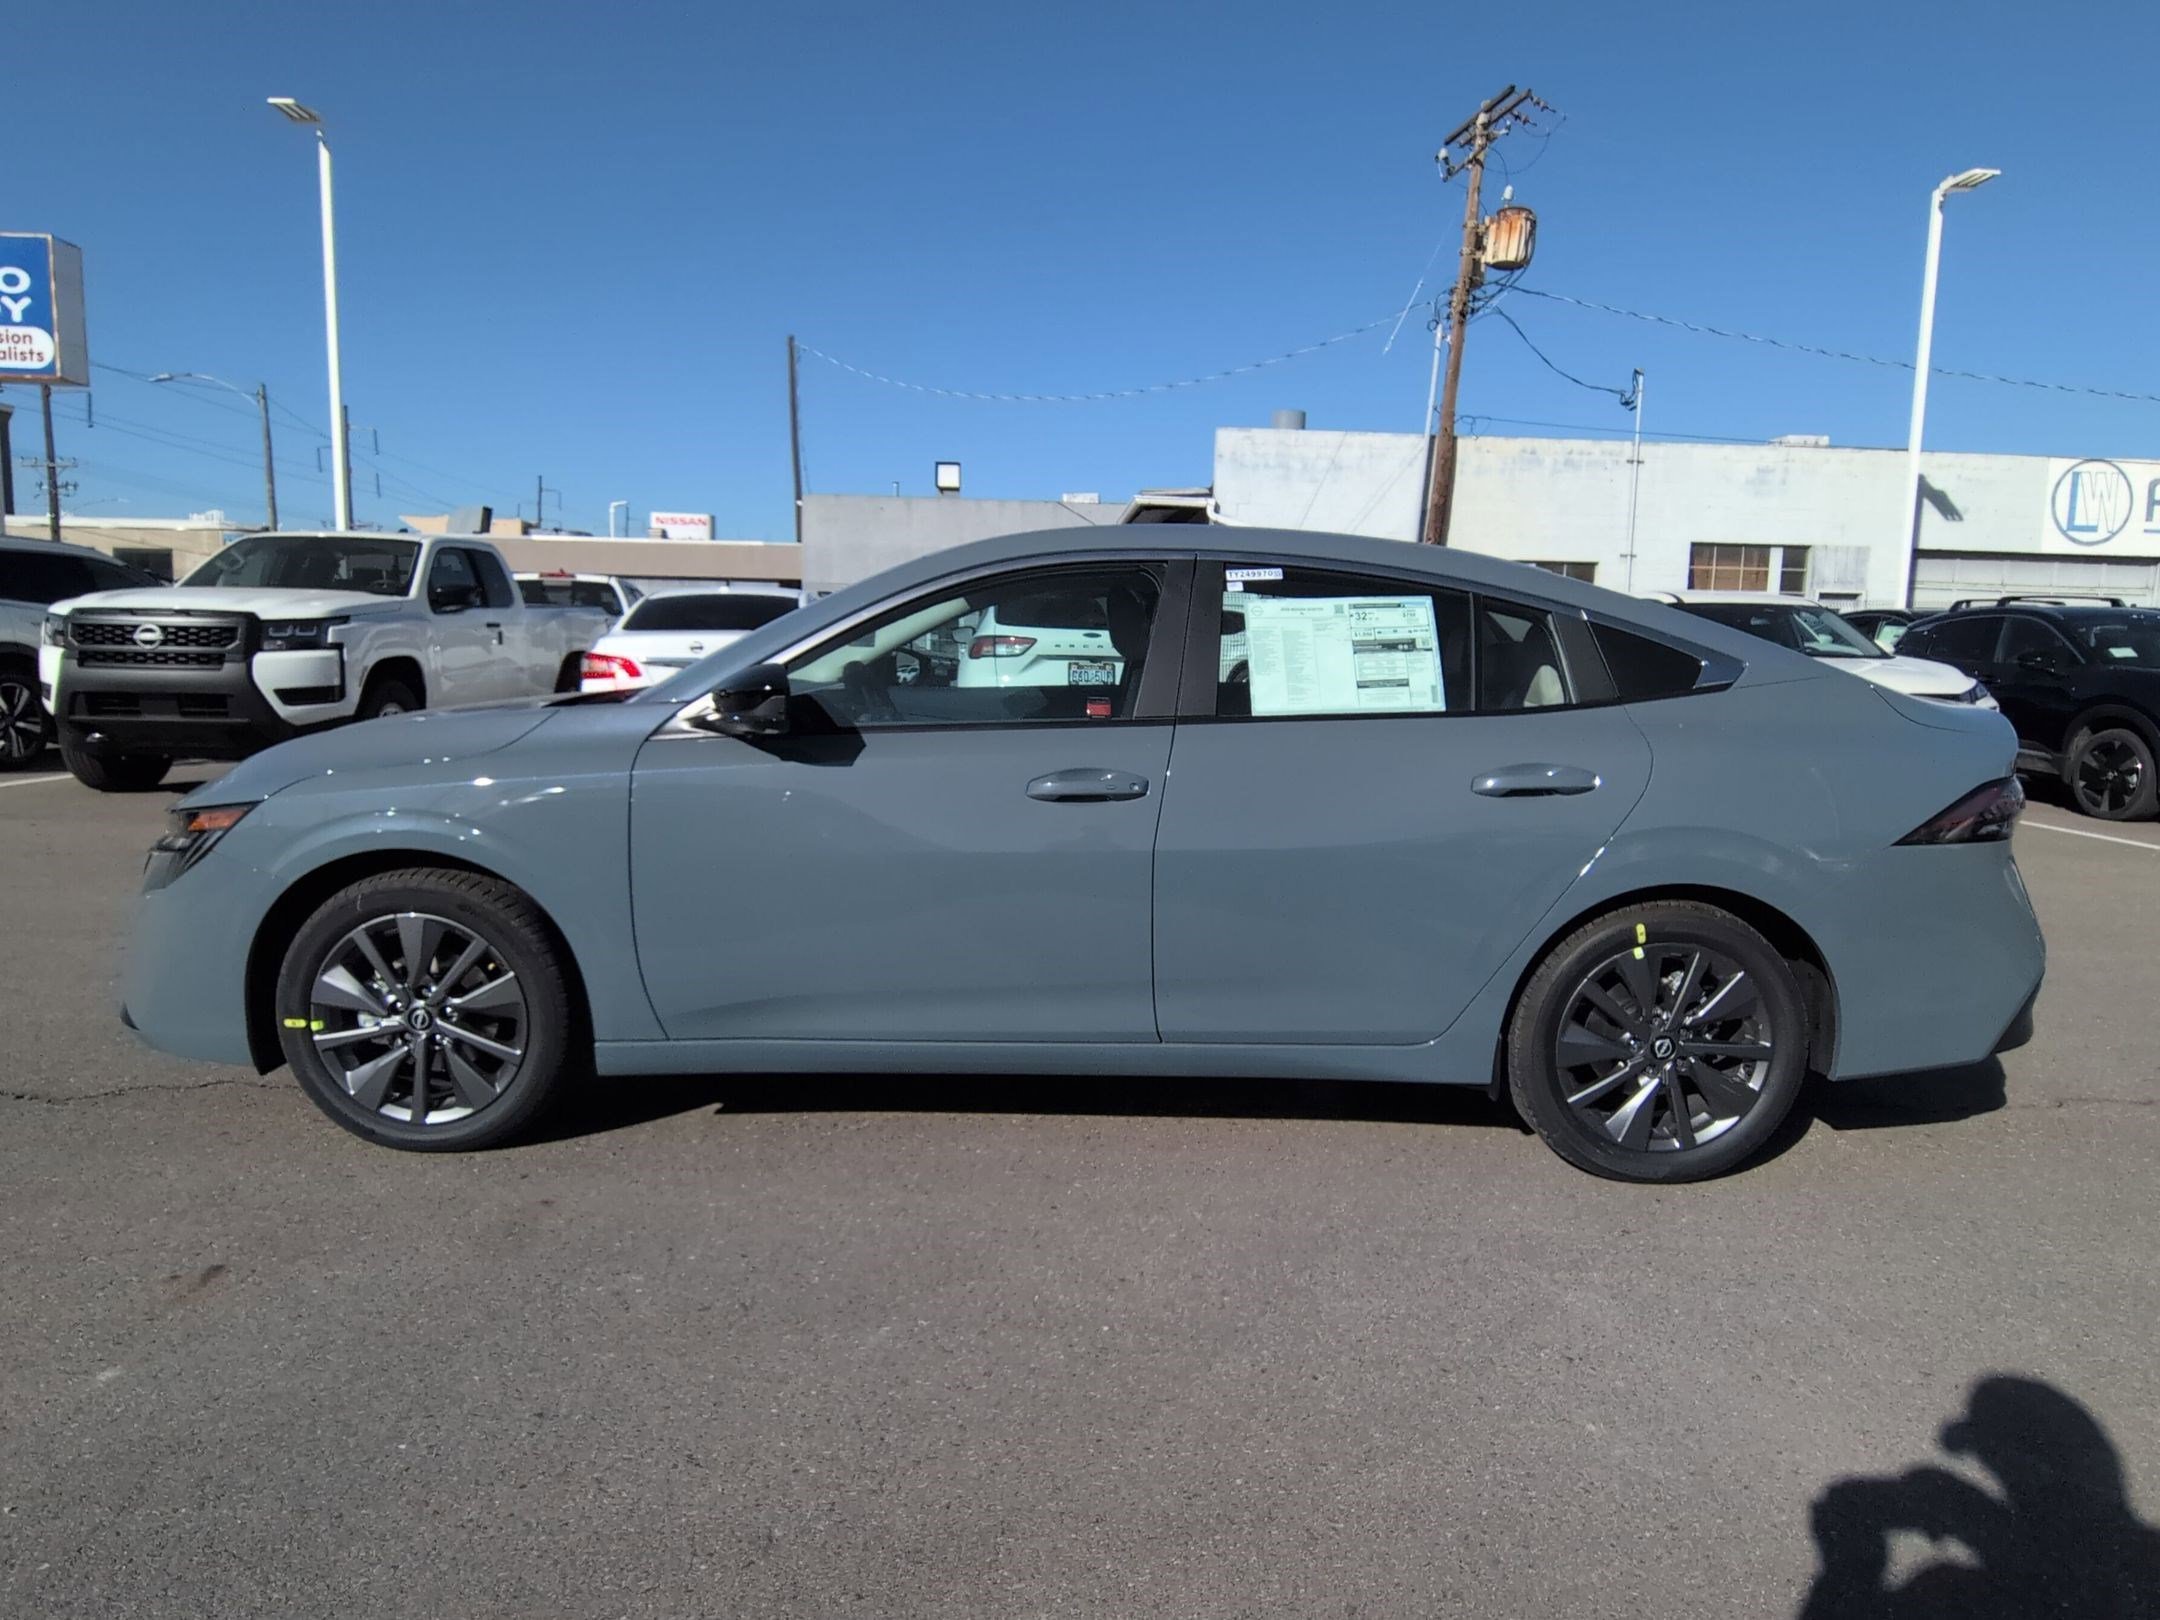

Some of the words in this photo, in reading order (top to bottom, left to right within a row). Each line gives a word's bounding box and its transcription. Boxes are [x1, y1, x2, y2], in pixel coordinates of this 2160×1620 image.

[0, 295, 32, 323] Y
[655, 516, 707, 526] NISSAN
[1354, 611, 1367, 621] 32
